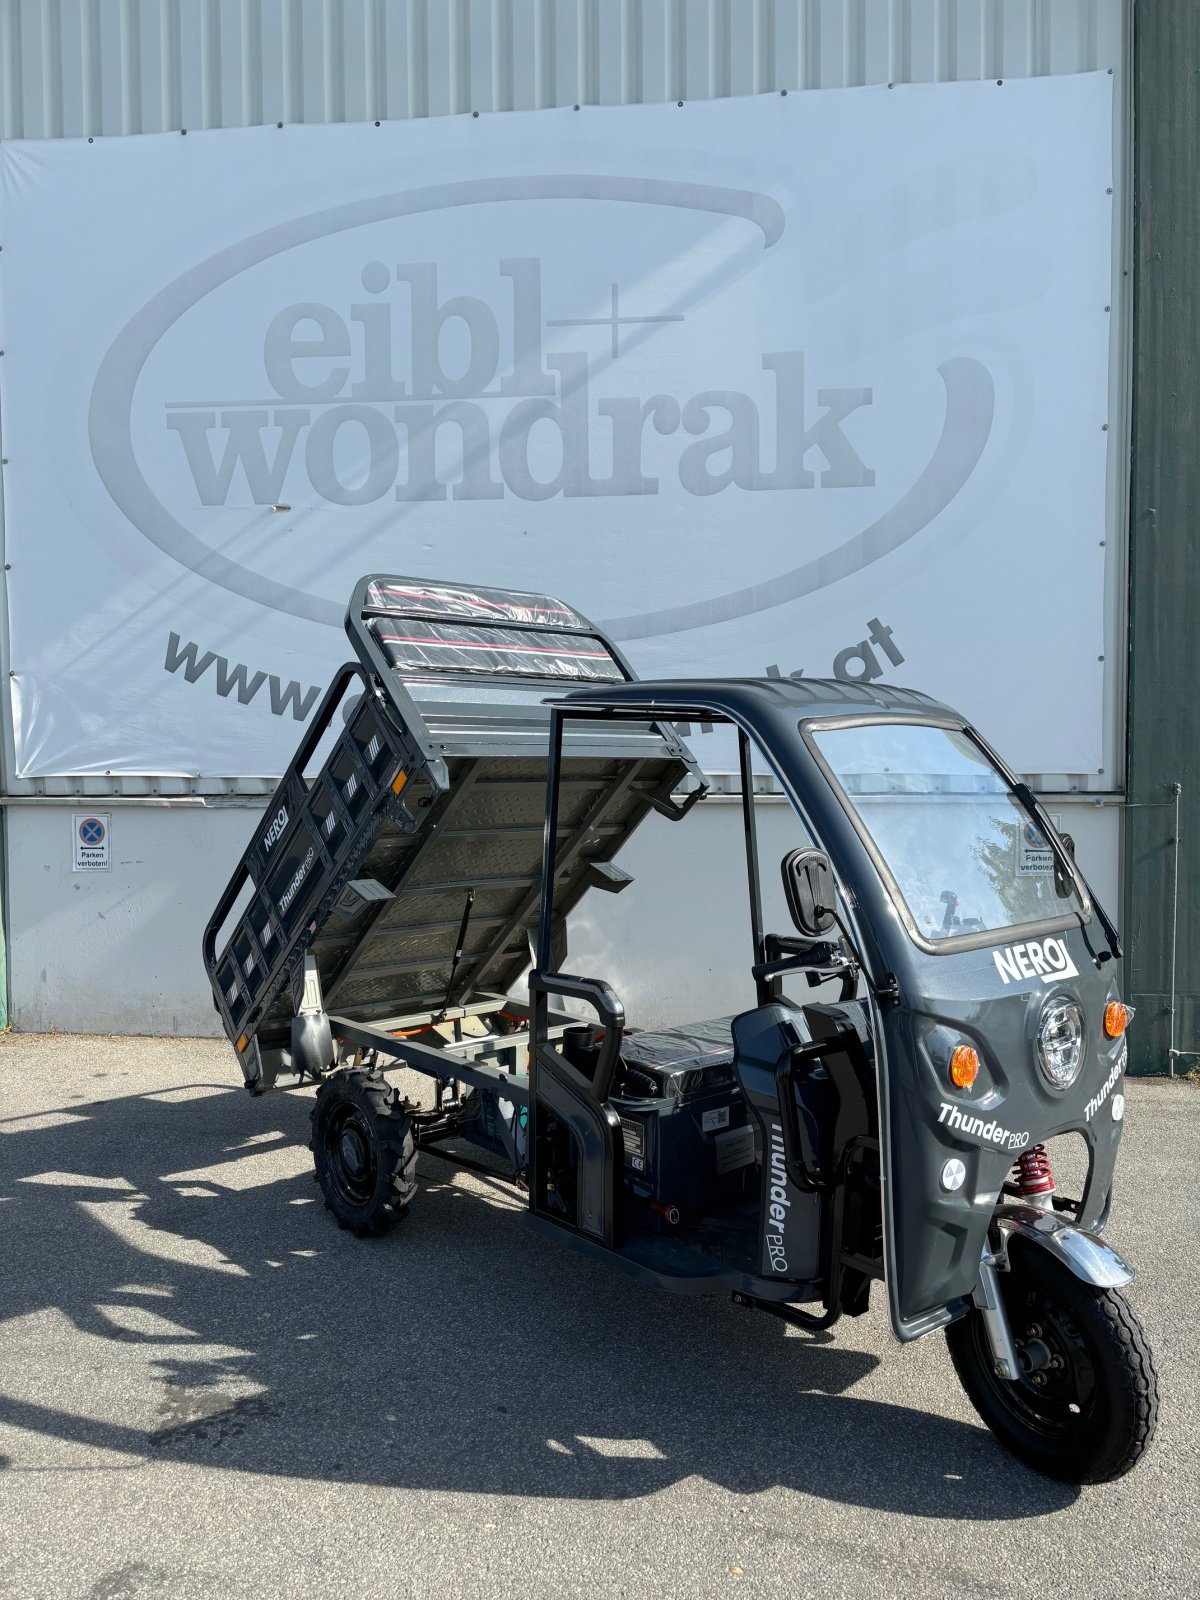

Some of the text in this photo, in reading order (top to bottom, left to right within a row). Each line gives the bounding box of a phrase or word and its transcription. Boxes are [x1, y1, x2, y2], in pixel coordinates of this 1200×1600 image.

[166, 351, 876, 506] wondrak
[264, 805, 289, 852] NERO
[992, 938, 1079, 984] NERO
